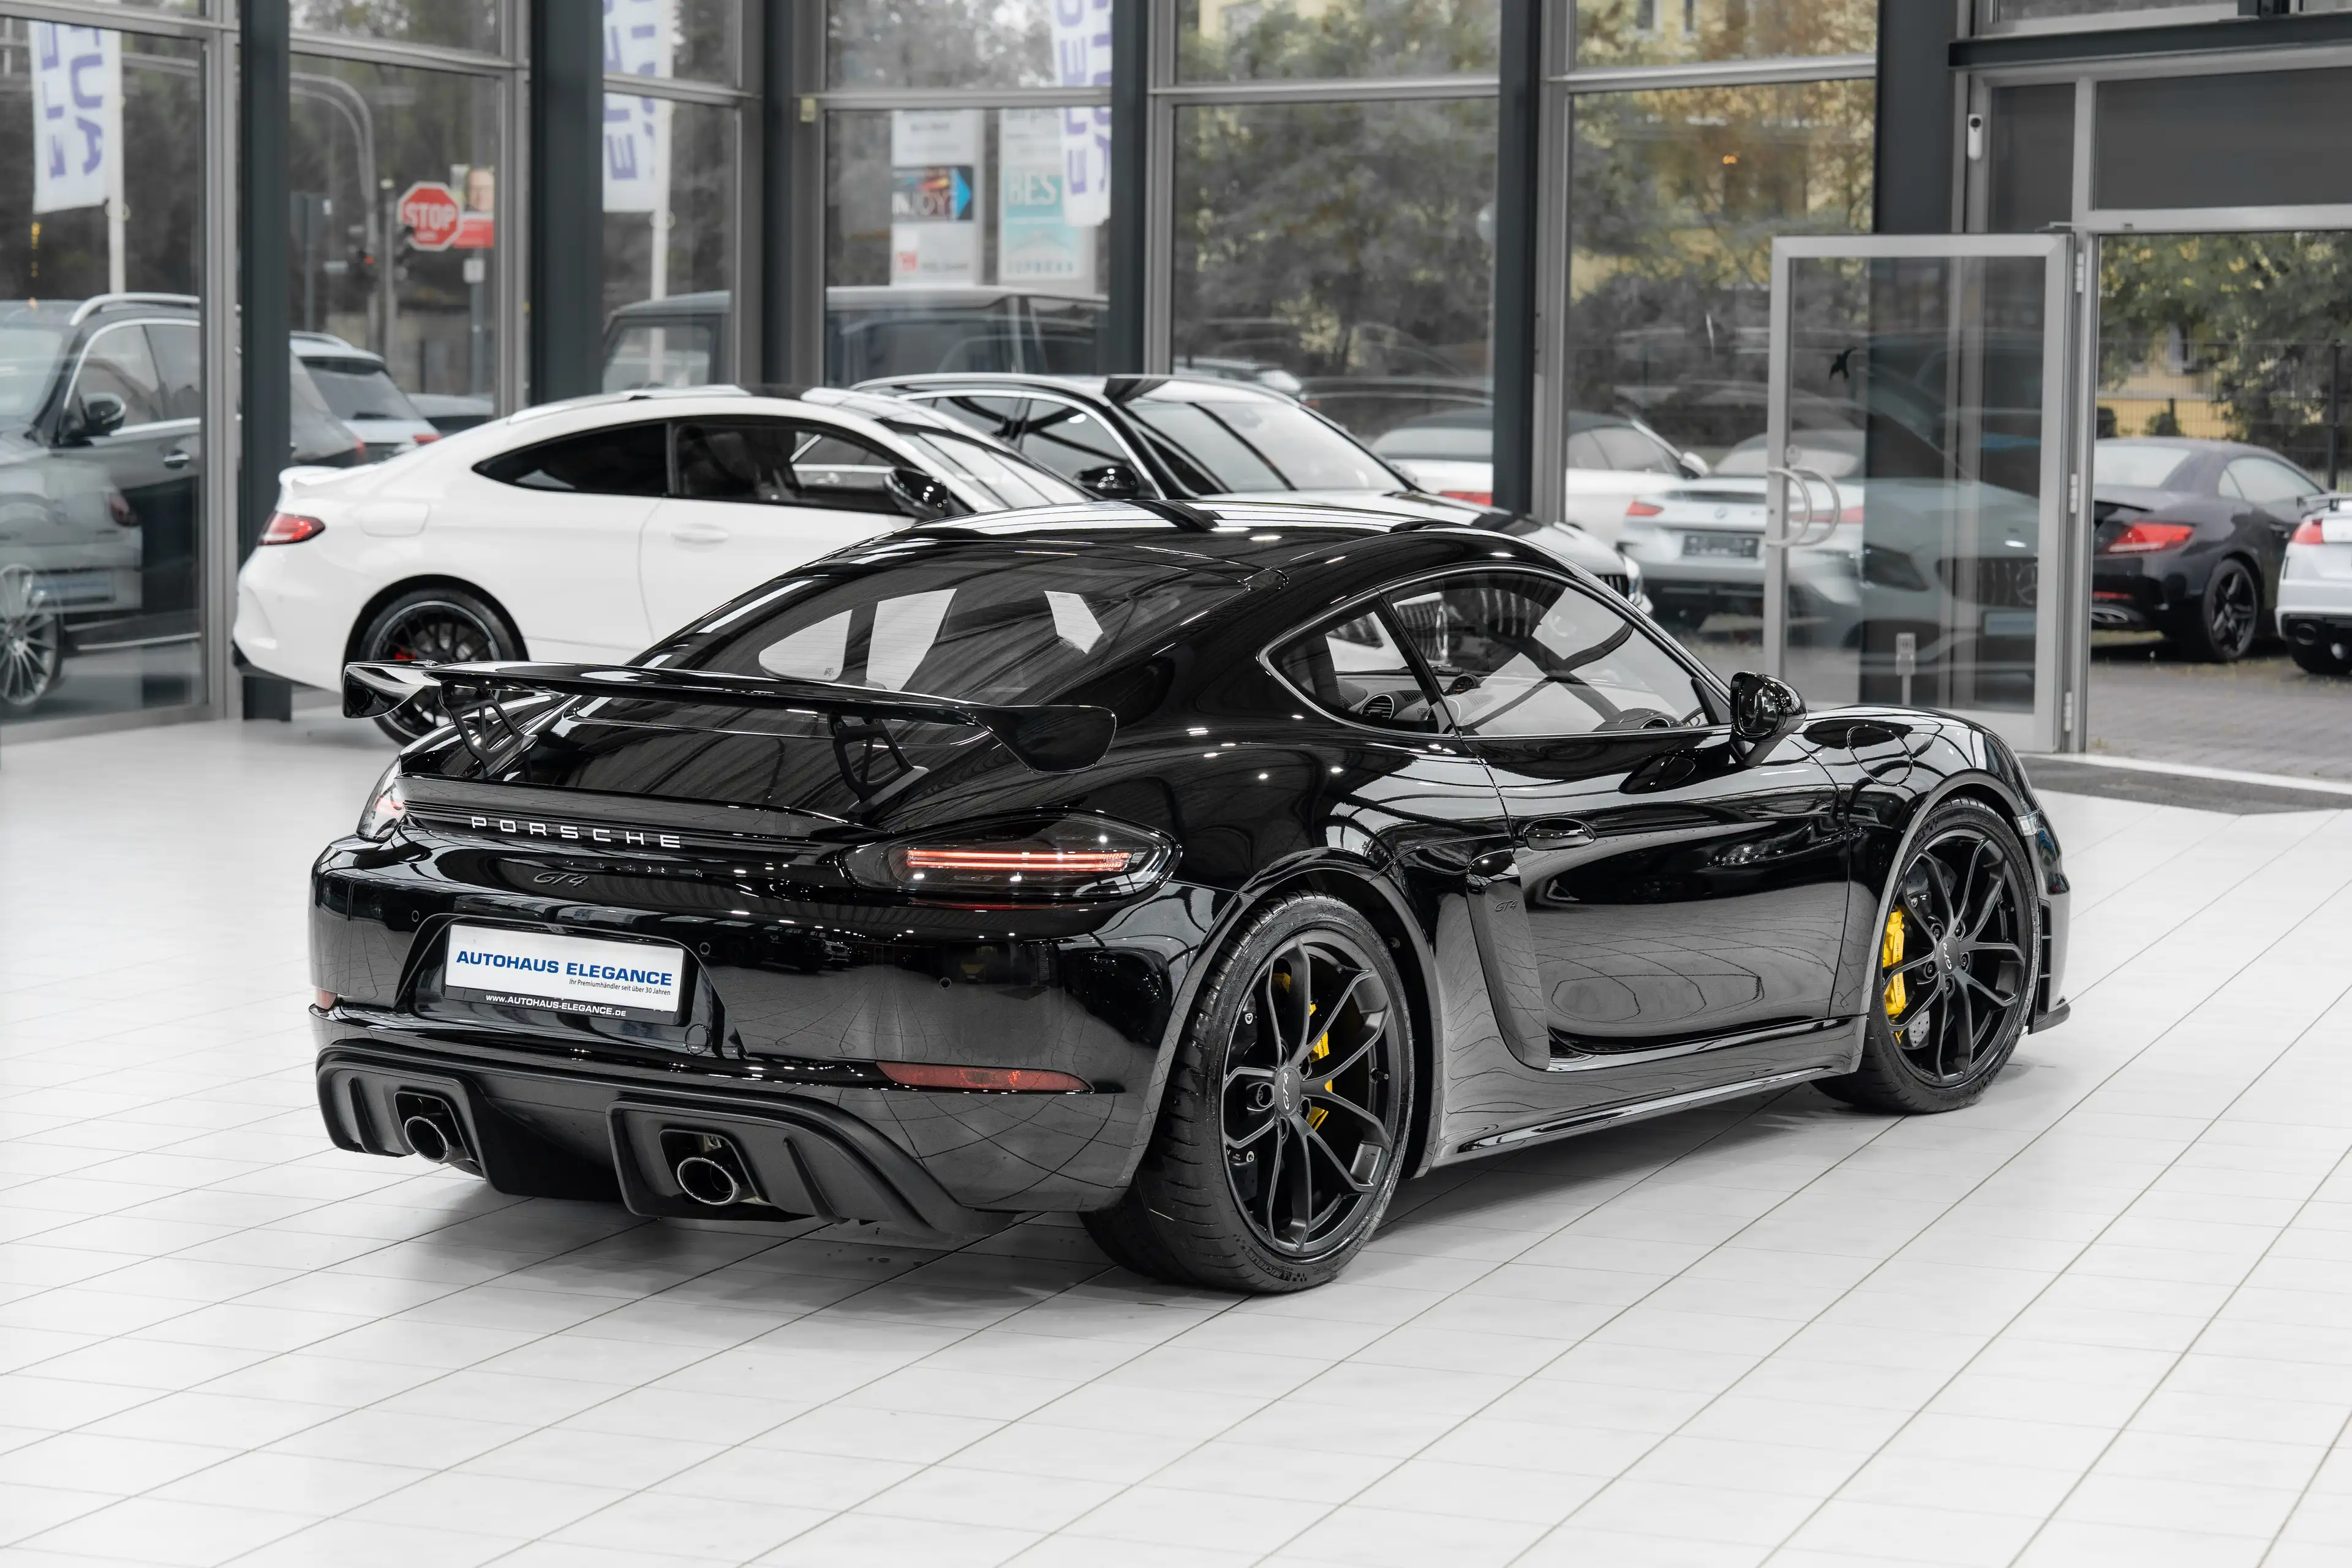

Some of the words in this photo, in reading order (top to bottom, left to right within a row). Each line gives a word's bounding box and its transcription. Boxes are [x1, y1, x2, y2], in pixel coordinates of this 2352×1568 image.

[405, 203, 456, 231] STOP
[471, 816, 680, 848] PORSCHE
[533, 872, 589, 888] GT4
[1494, 899, 1517, 912] GT4
[456, 951, 559, 974] AUTOHAUS
[567, 962, 673, 987] ELEGANCE
[1942, 943, 1952, 970] GT4
[578, 979, 620, 990] Premiumhändler
